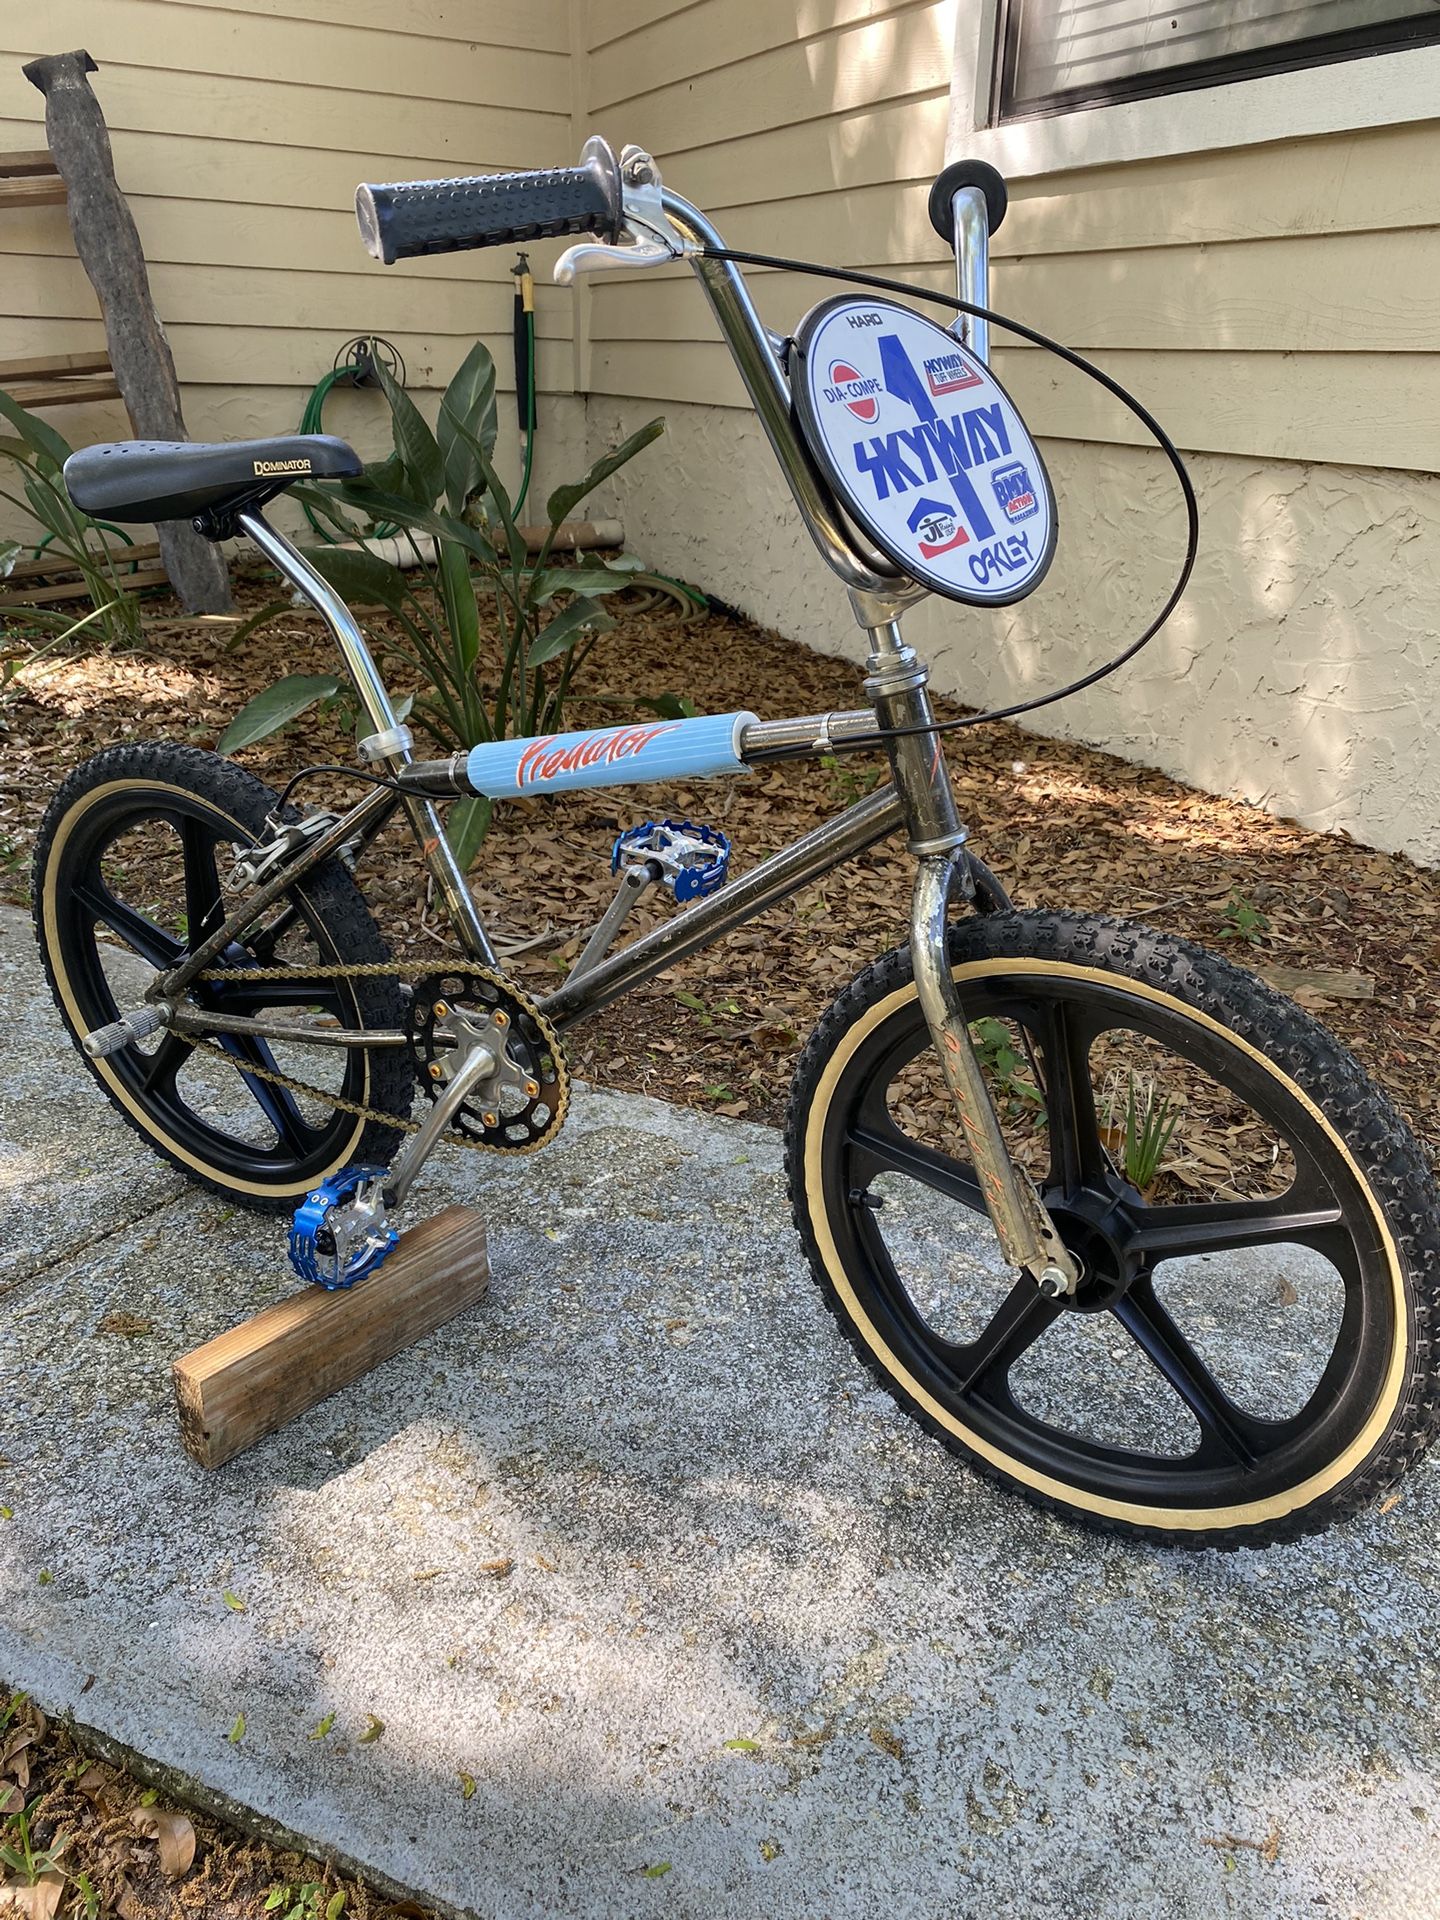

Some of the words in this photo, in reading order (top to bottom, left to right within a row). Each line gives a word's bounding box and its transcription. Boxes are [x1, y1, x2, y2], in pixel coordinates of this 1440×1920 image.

[846, 313, 883, 329] HARO
[923, 353, 963, 374] SKYWAY
[934, 372, 948, 384] TUFF
[946, 367, 968, 381] WHEELS
[823, 378, 883, 403] DIA-COMPE
[853, 402, 1012, 501] SKYWAY
[253, 459, 311, 475] DOMINATOR
[991, 469, 1035, 509] BMX
[1007, 491, 1033, 513] ACTION
[968, 531, 1034, 585] OAKLEY
